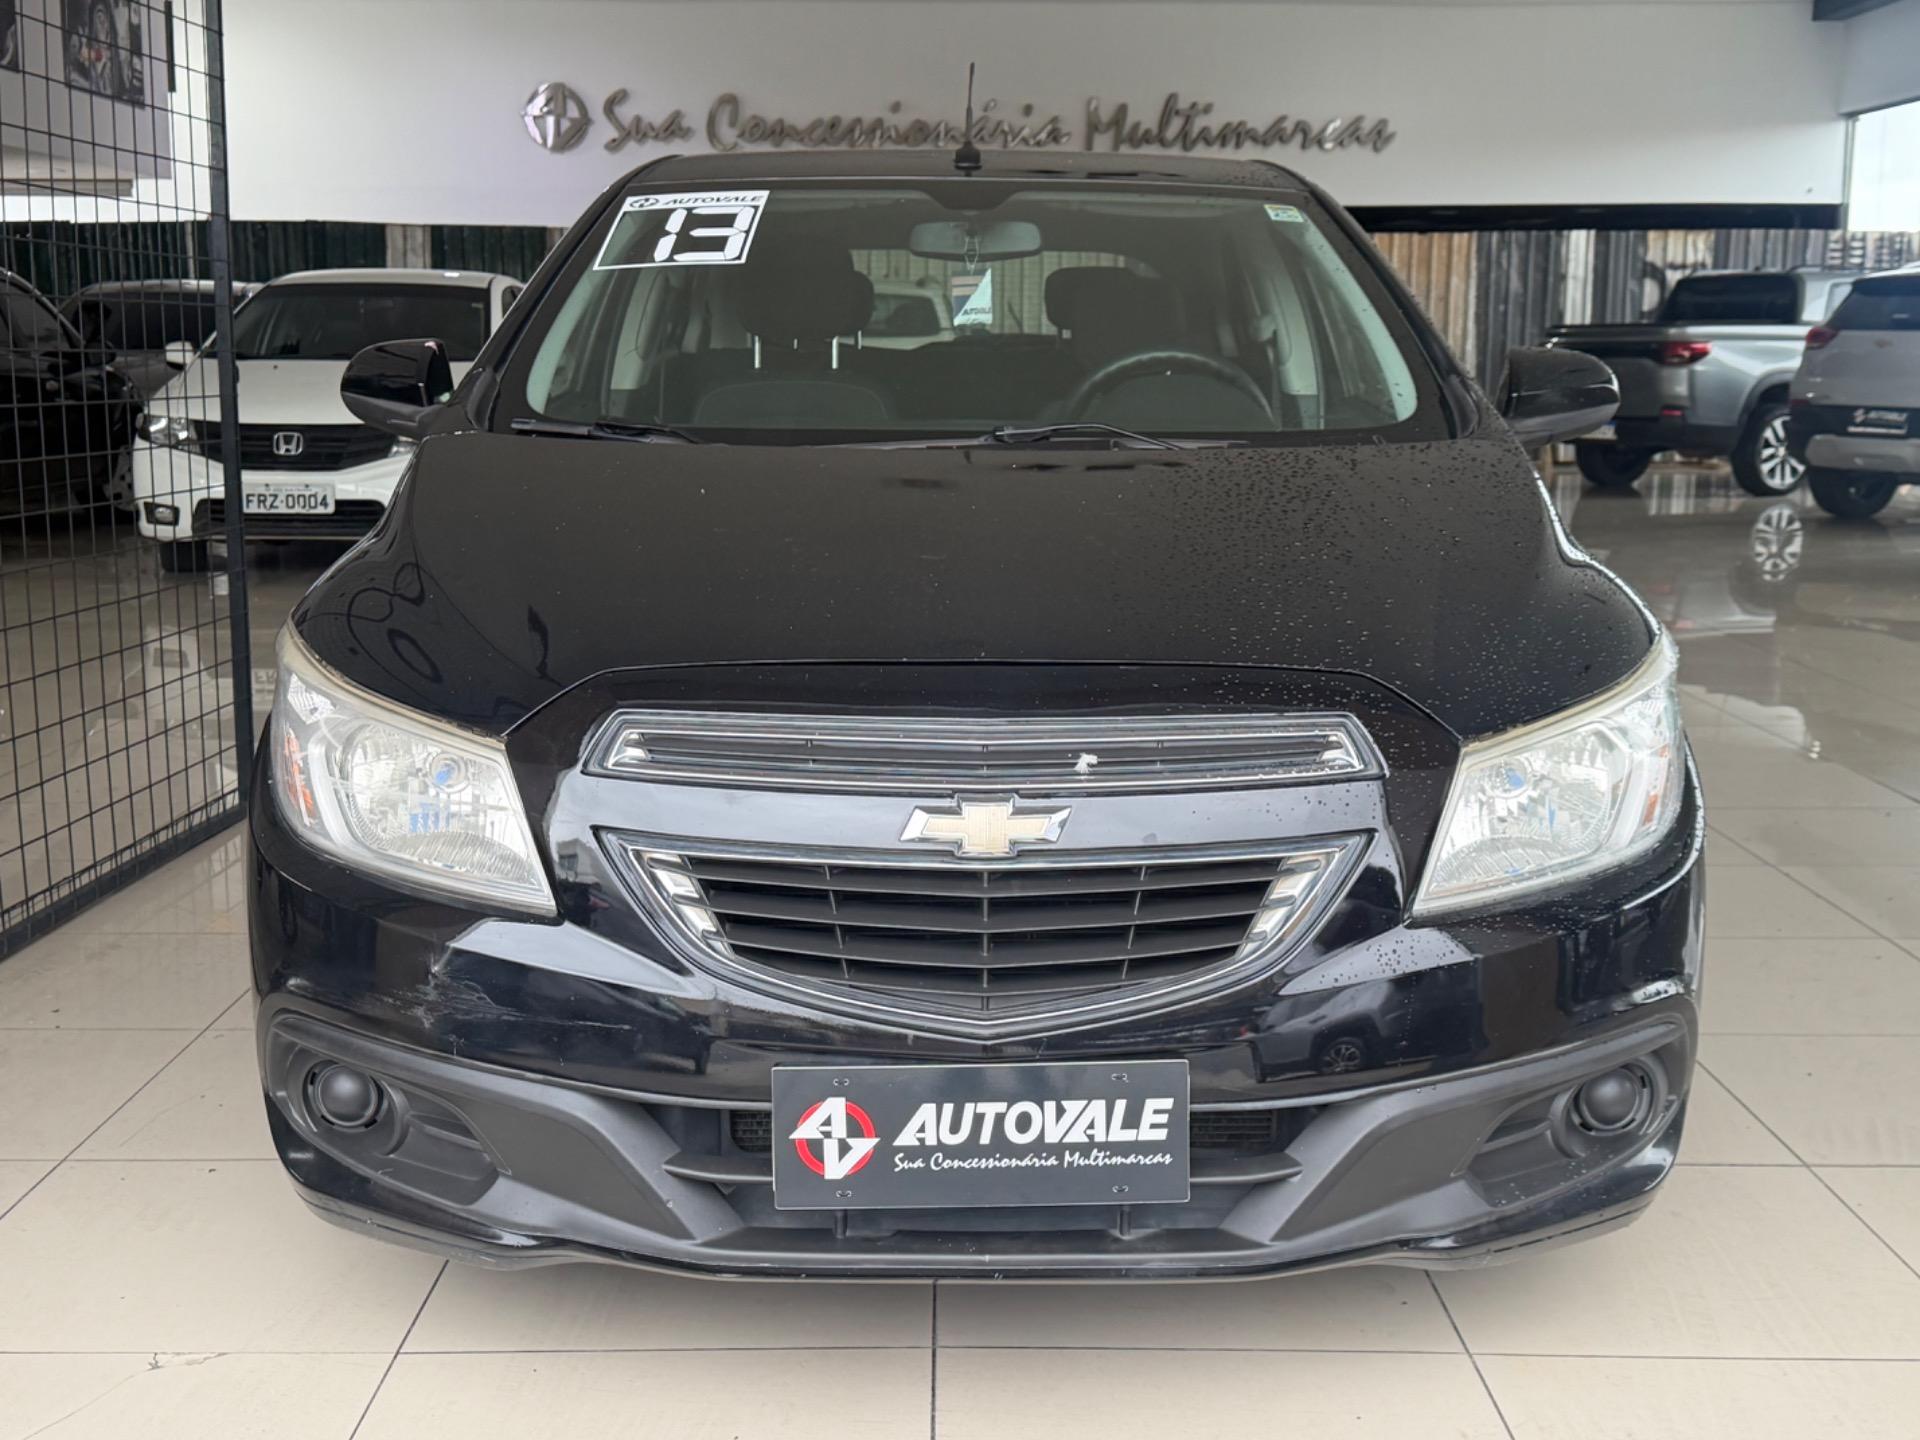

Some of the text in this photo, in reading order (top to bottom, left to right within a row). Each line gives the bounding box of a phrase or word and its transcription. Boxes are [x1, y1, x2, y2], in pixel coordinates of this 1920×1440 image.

[603, 88, 695, 154] Sua
[1084, 92, 1397, 153] Multimarcas
[662, 195, 764, 206] AUTOVALE
[653, 206, 755, 262] 13
[893, 1098, 1175, 1146] AUTOVALE
[893, 1147, 1174, 1172] Sua Concessionária Multimarcas
